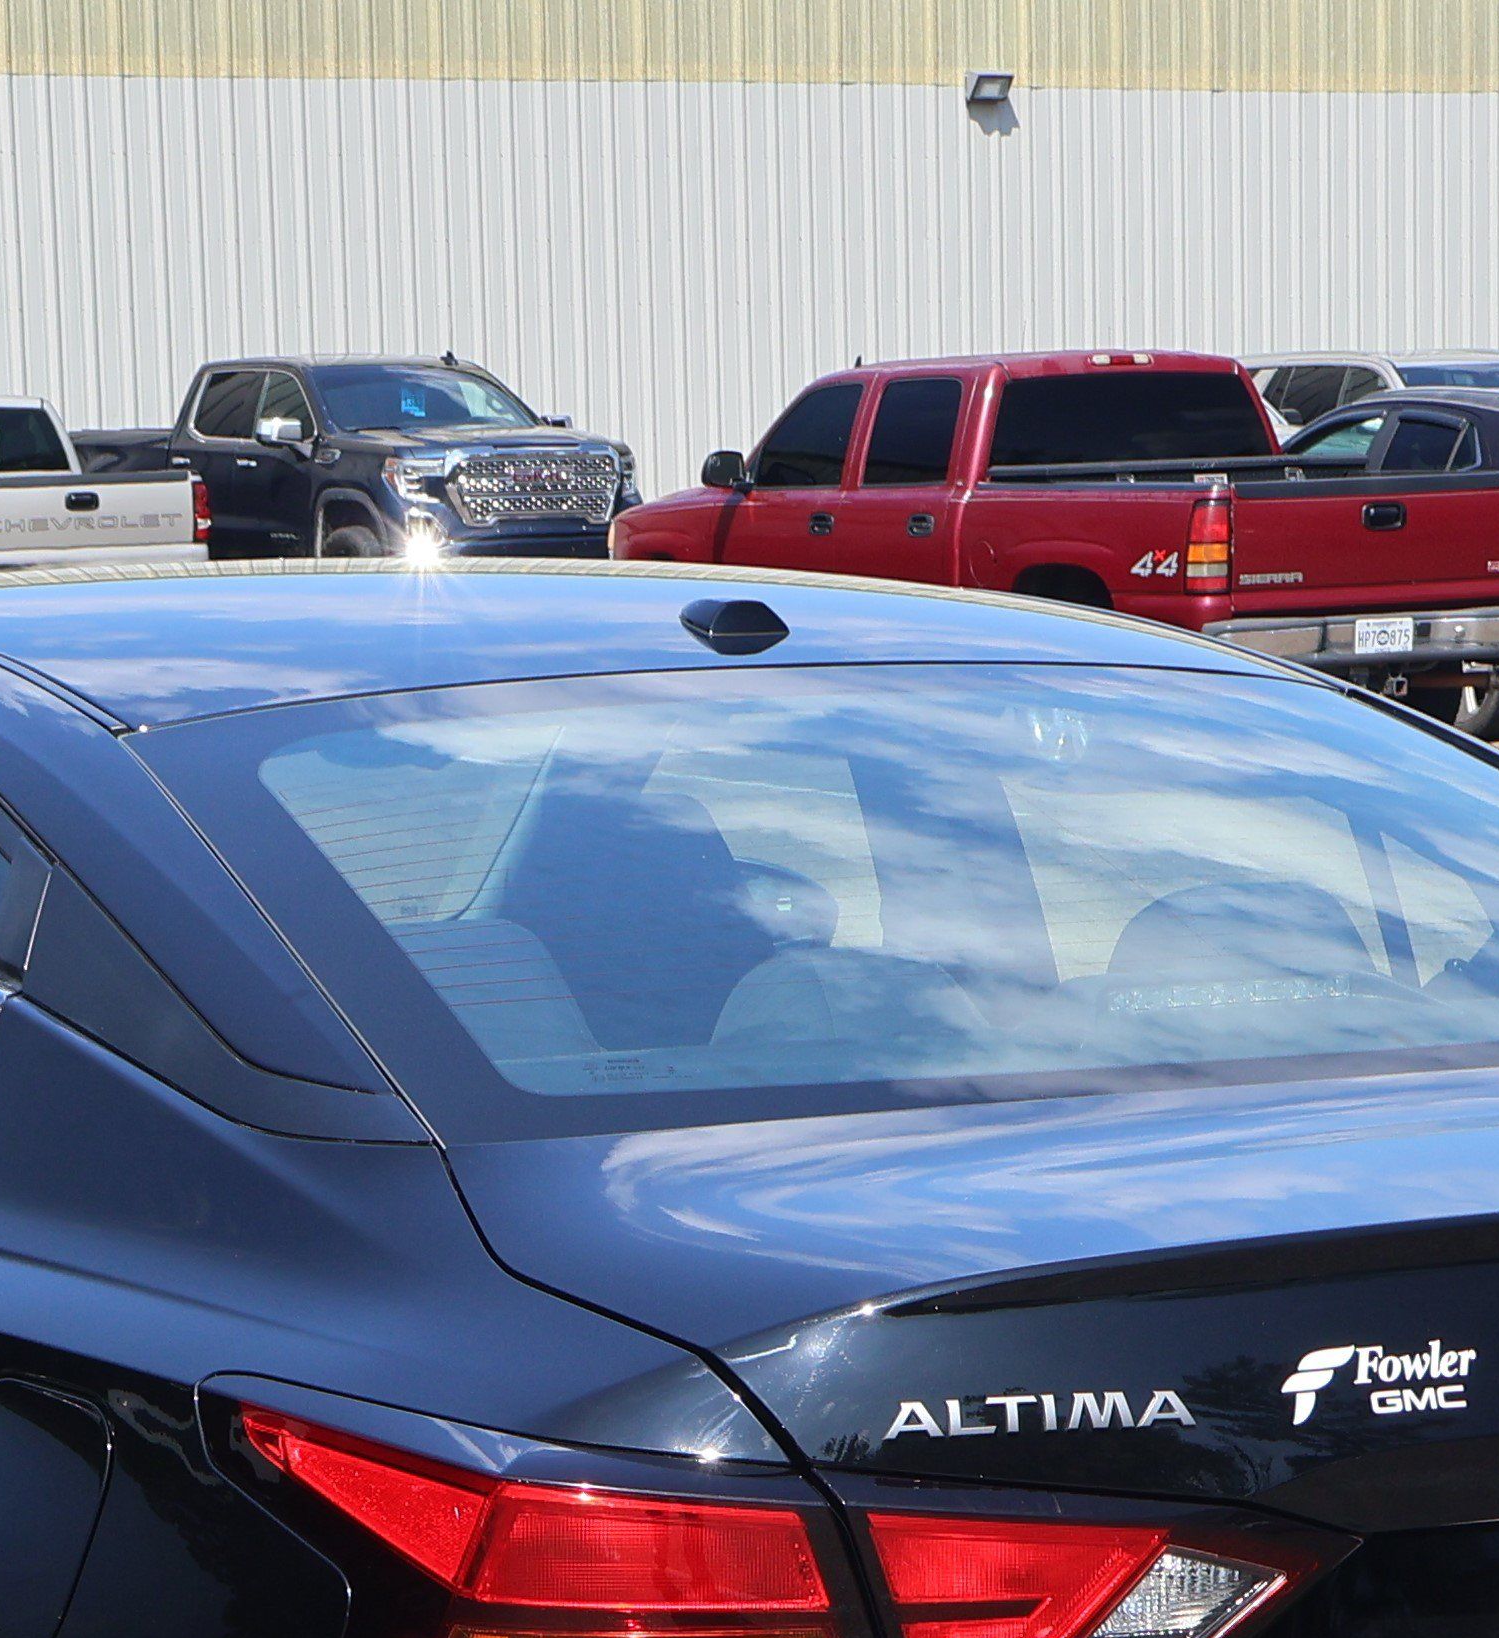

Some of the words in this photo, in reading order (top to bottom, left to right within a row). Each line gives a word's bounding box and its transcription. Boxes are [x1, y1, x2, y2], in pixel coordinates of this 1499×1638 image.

[1353, 1339, 1477, 1385] Fowler
[882, 1389, 1197, 1441] ALTIMA
[1369, 1384, 1468, 1414] GMC
